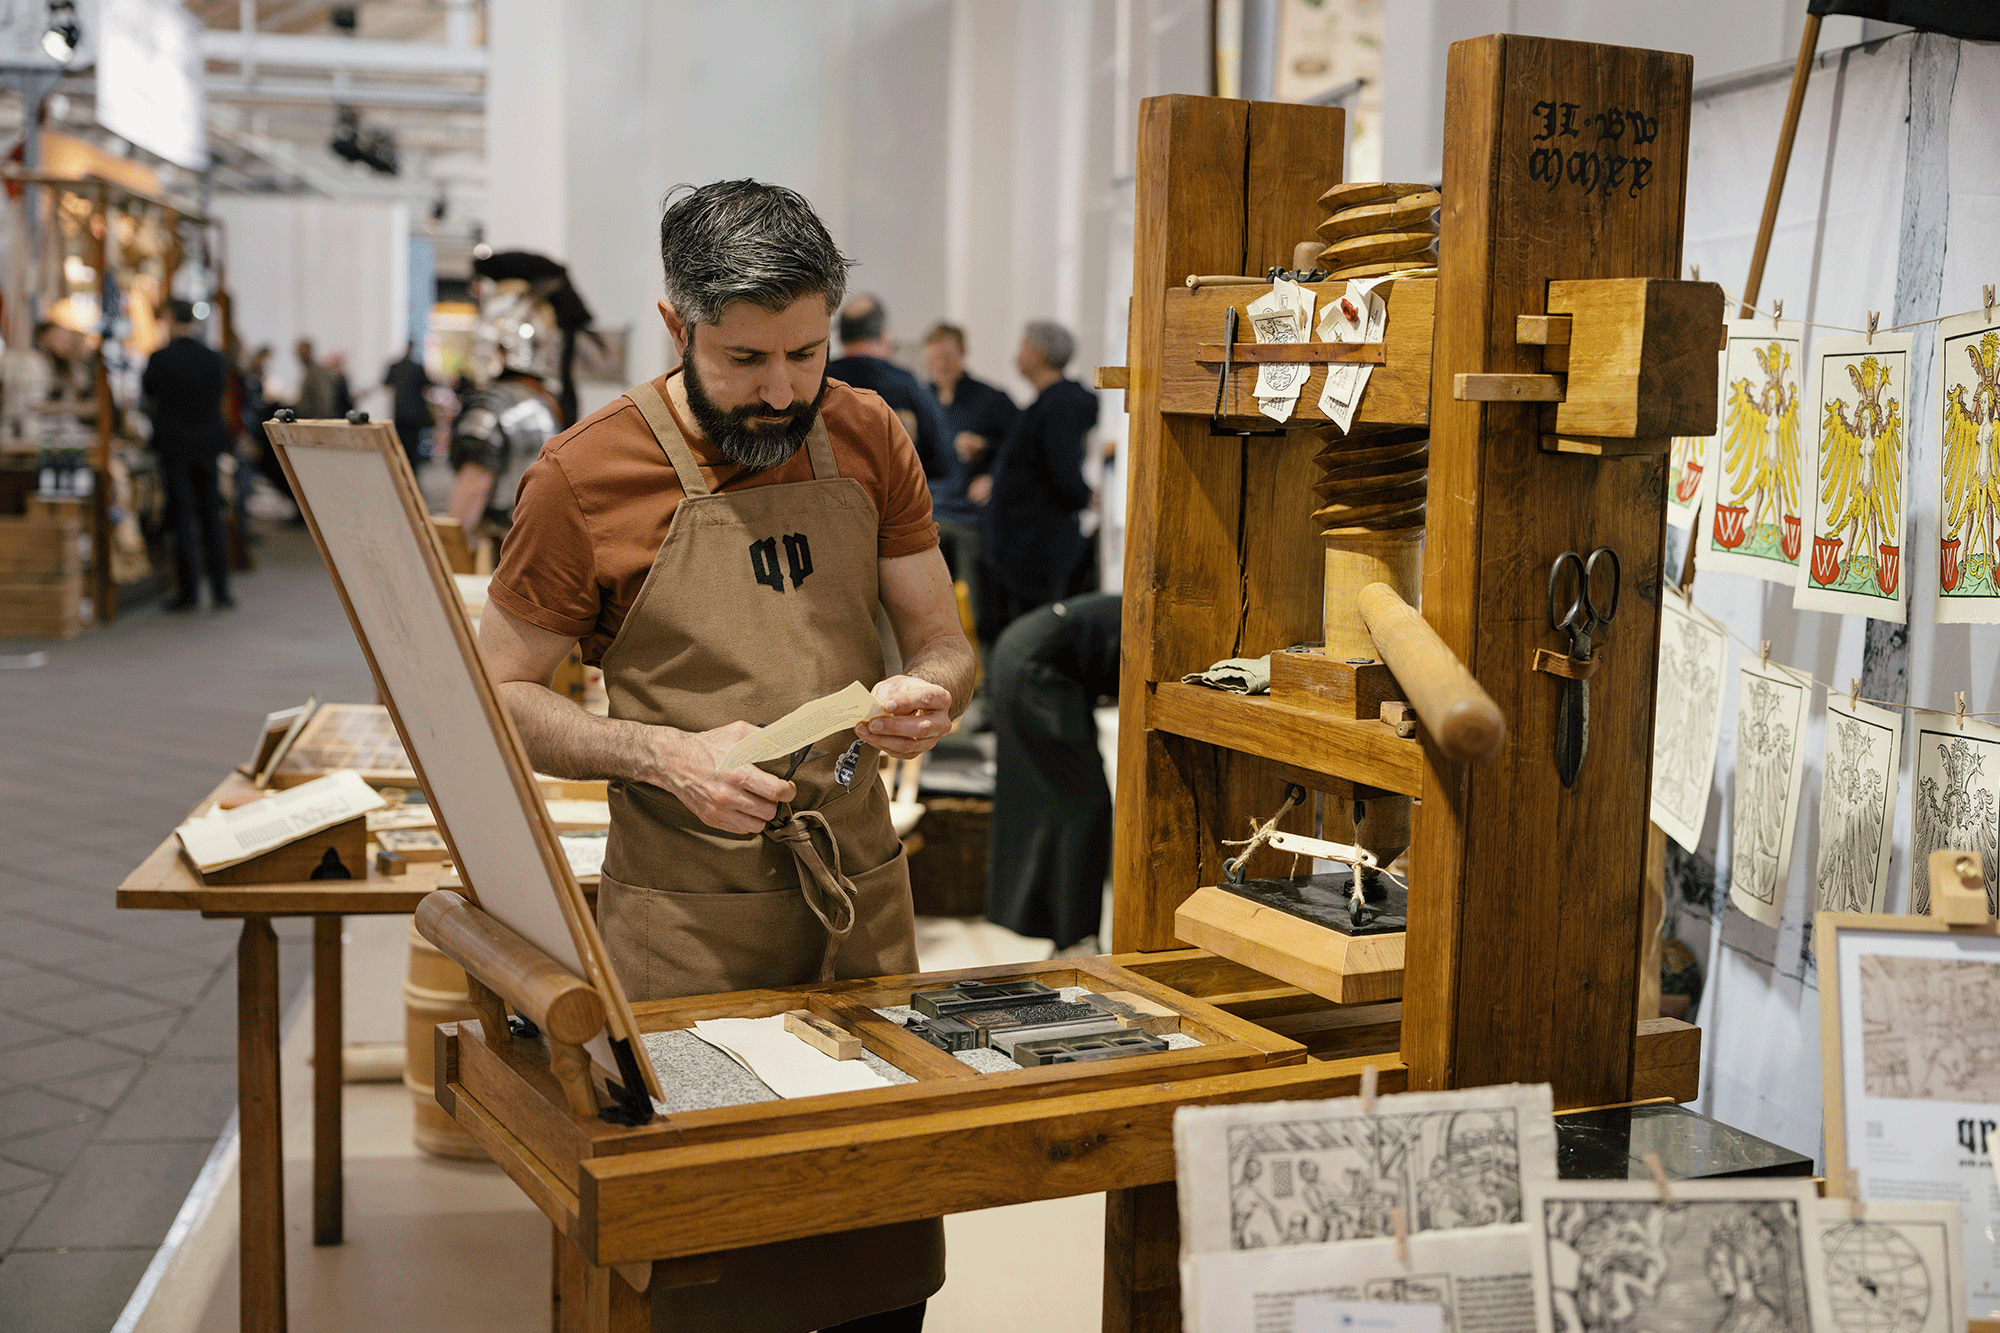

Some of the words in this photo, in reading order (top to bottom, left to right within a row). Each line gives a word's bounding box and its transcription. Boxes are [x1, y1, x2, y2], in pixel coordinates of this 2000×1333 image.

[1717, 510, 1744, 541] W
[1786, 522, 1800, 555] W
[1815, 544, 1838, 577] W
[1881, 553, 1898, 589] W
[1941, 547, 1958, 583] W
